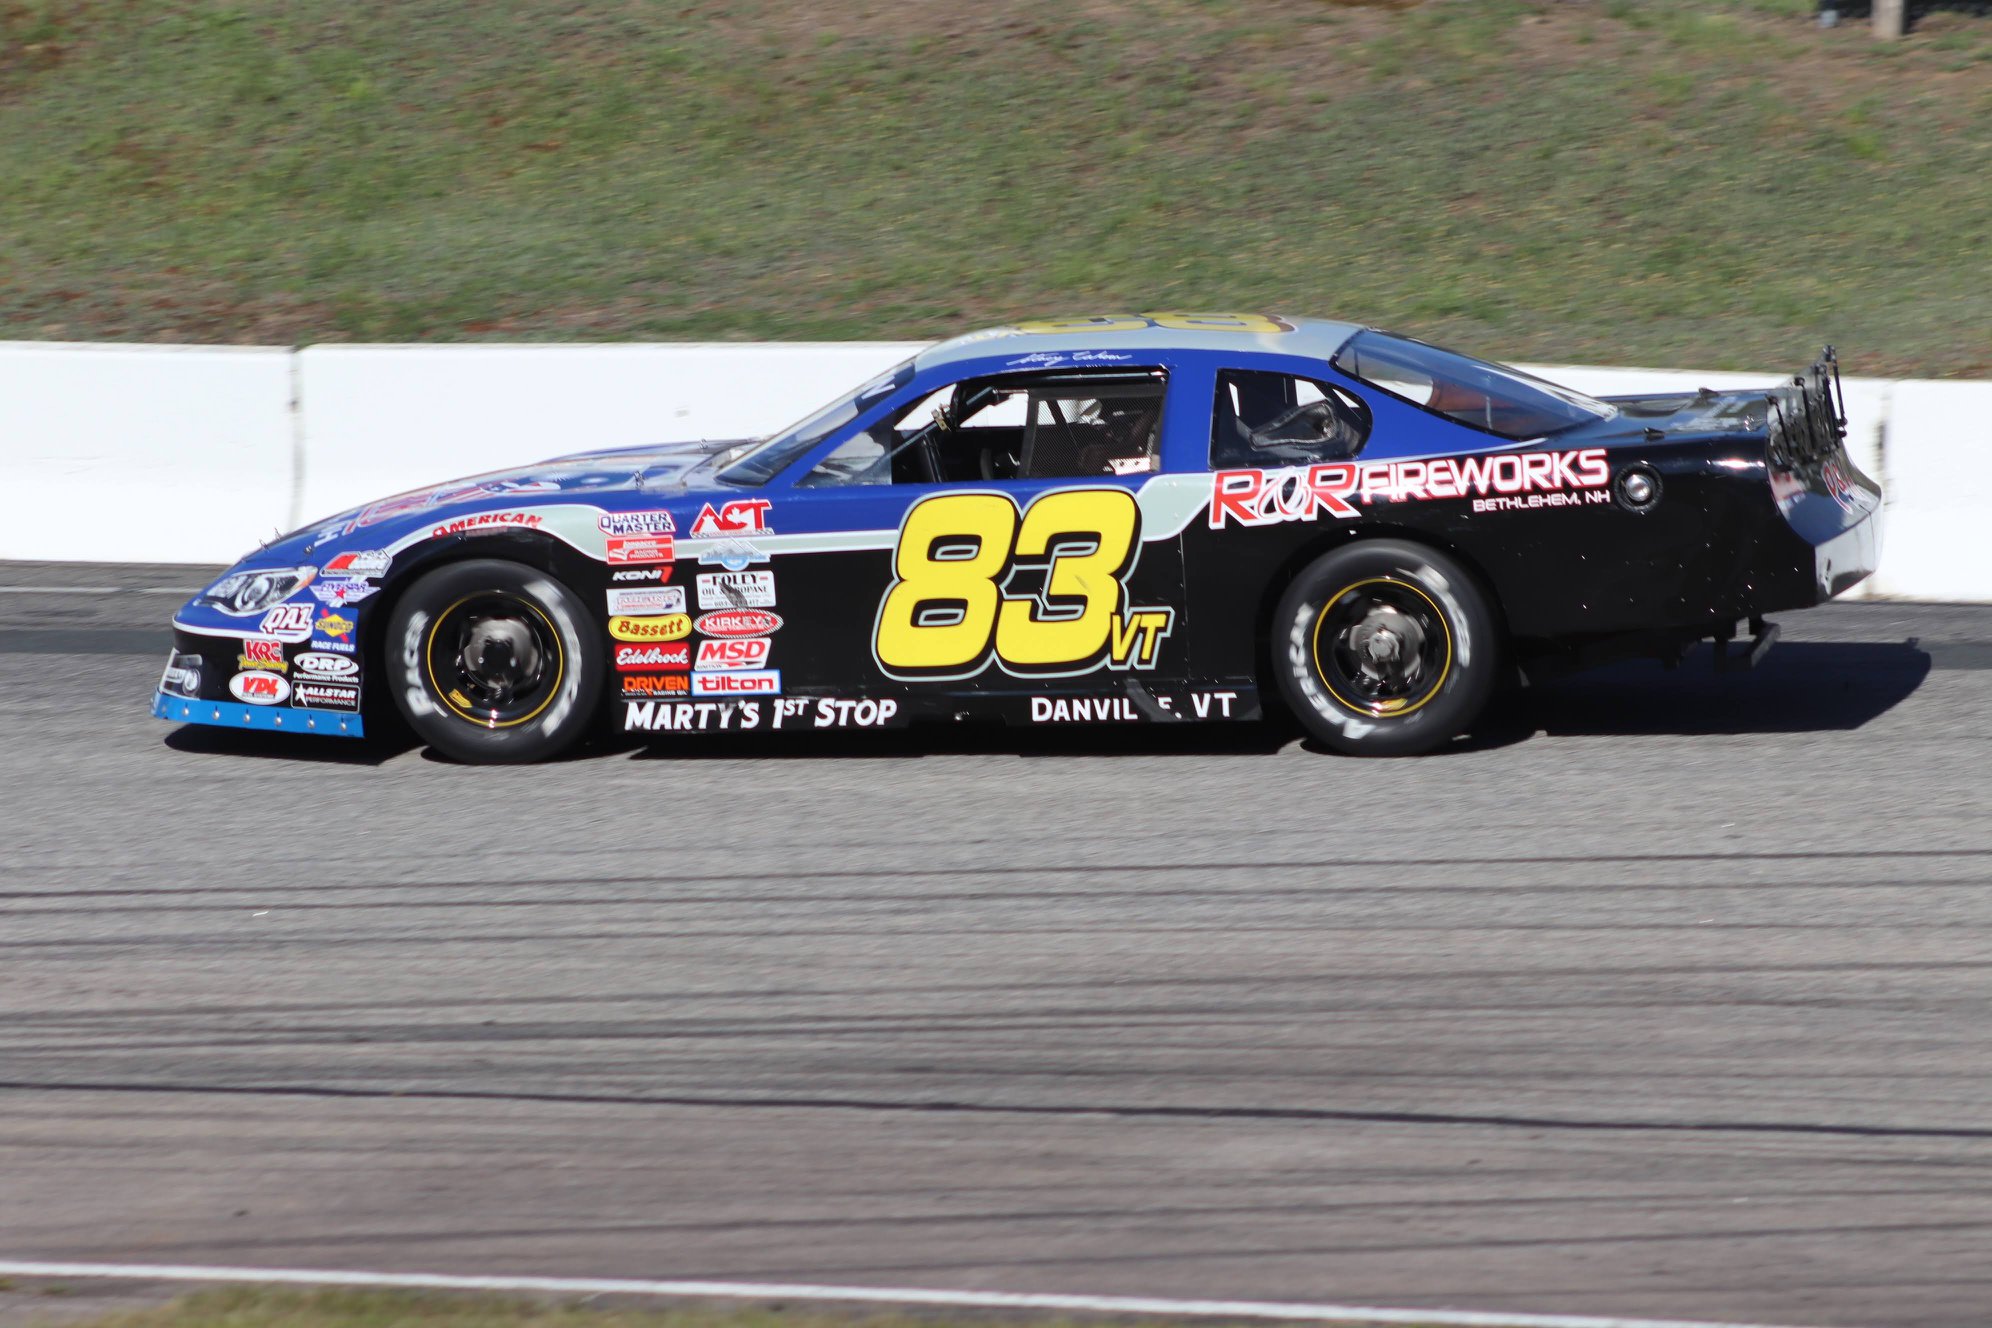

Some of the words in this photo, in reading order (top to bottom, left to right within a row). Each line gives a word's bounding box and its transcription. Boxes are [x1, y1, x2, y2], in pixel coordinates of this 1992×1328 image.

[1360, 449, 1610, 505] FIREWORKS
[1473, 492, 1582, 513] BETHLEHEM,
[1585, 490, 1611, 504] NH
[432, 512, 543, 540] AMERICAN
[601, 513, 667, 529] QUARTER
[692, 502, 770, 533] ACT
[613, 522, 671, 535] MASTER
[612, 569, 663, 581] KONI
[712, 574, 758, 586] FOLEY
[874, 487, 1140, 676] 83
[262, 605, 312, 635] QA1
[618, 619, 684, 637] Bassett
[1109, 611, 1170, 663] VT
[244, 641, 282, 663] KRC
[616, 647, 689, 666] Edelbrock
[700, 640, 767, 661] MSD
[301, 656, 353, 671] DRP
[304, 686, 357, 699] ALLSTAR
[623, 675, 689, 691] DRIVEN
[697, 675, 774, 692] tilton
[623, 700, 760, 731] MARTY'S
[814, 697, 898, 728] STOP
[1191, 692, 1238, 719] VT
